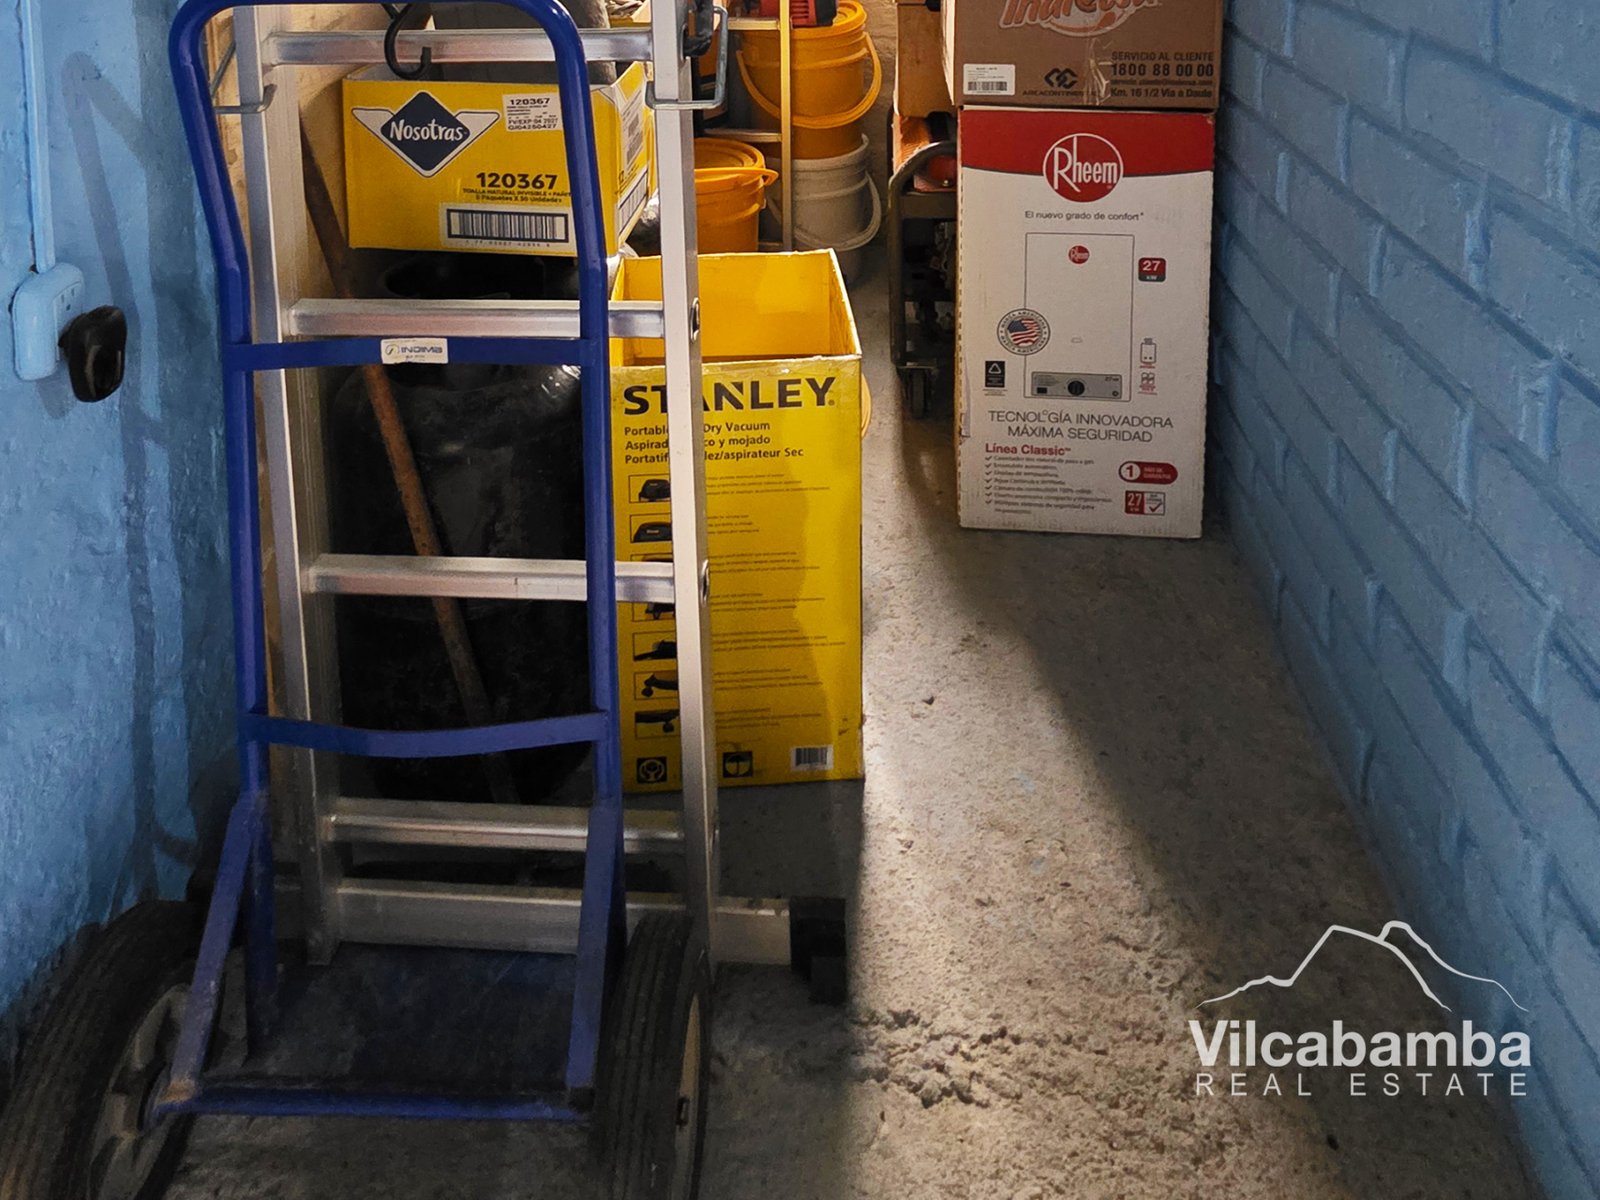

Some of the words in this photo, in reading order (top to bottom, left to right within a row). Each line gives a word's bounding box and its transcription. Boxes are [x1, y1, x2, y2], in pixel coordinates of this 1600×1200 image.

[1111, 51, 1157, 62] SERVICIO
[1158, 51, 1171, 62] AL
[1173, 51, 1214, 62] CLIENTE
[1111, 63, 1147, 77] 1800
[1152, 63, 1171, 77] 88
[1175, 63, 1193, 77] 00
[1196, 63, 1214, 77] 00
[509, 97, 551, 106] 120367
[389, 118, 465, 142] Nosotras
[1053, 136, 1118, 192] Rheem
[476, 171, 558, 190] 120367
[1025, 210, 1034, 219] El
[1036, 212, 1064, 220] nuevo
[1065, 211, 1090, 221] grado
[1093, 211, 1106, 220] de
[1142, 260, 1161, 272] 27
[624, 376, 836, 416] STNLEY
[725, 421, 771, 433] Vacuum
[1076, 413, 1174, 429] INNOVADORA
[1007, 423, 1064, 439] MÁXIMA
[1067, 427, 1153, 443] SEGURIDAD
[625, 439, 669, 452] Aspirad
[719, 437, 726, 449] y
[728, 434, 771, 448] mojado
[985, 443, 1018, 454] Línea
[784, 446, 804, 459] Sec
[1125, 465, 1134, 478] 1
